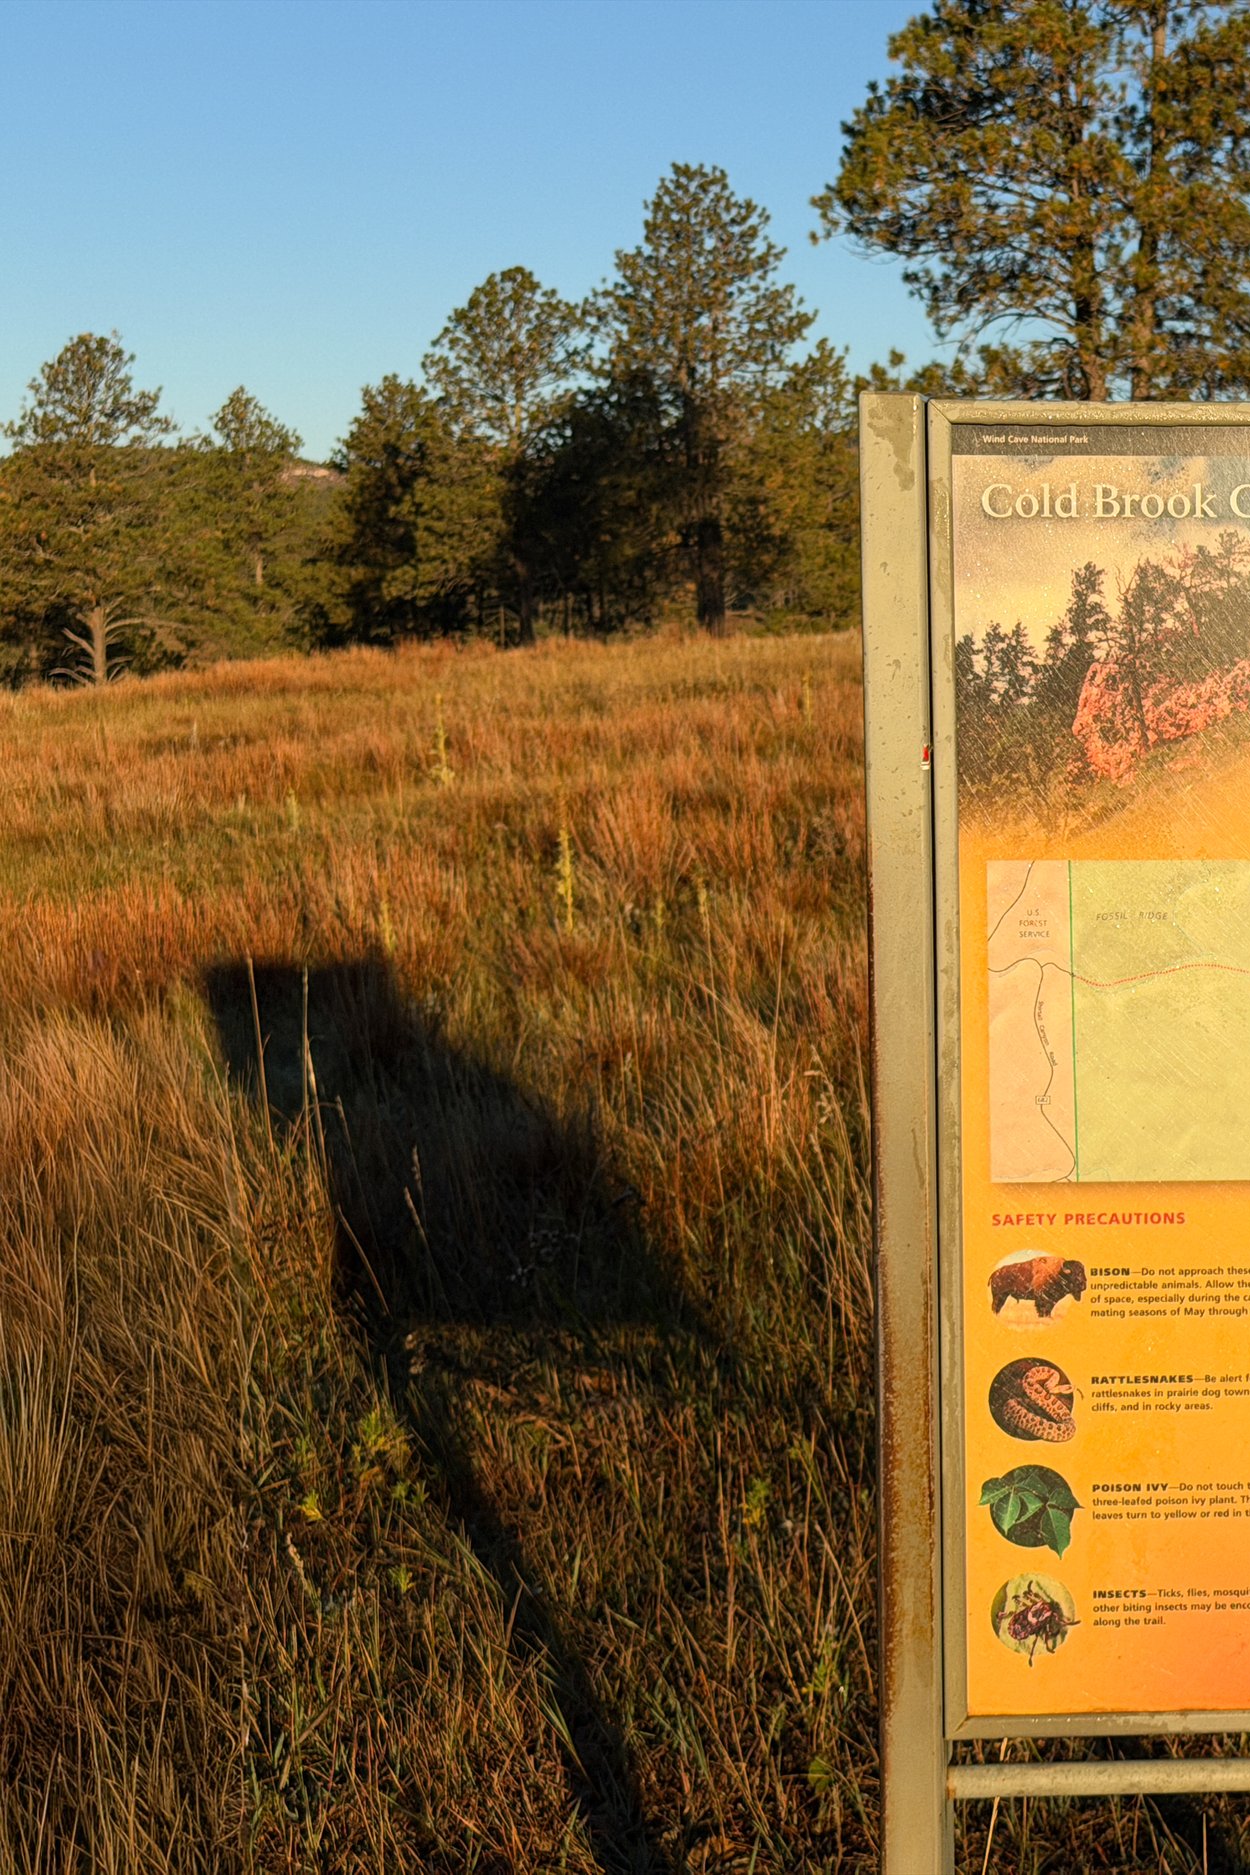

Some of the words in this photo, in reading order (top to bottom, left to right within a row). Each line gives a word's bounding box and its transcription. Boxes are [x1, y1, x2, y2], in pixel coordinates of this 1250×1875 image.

[981, 434, 1005, 444] Wind
[1007, 434, 1028, 444] Cave
[1030, 434, 1067, 444] National
[1069, 434, 1088, 444] Park
[981, 482, 1079, 519] Cold
[1093, 482, 1217, 519] Brook
[991, 1213, 1056, 1226] SAFETY
[1064, 1211, 1185, 1226] PRECAUTIONS
[1158, 1266, 1175, 1276] not
[1178, 1266, 1224, 1278] approach
[1090, 1280, 1158, 1292] unpredictable
[1161, 1279, 1201, 1290] animals.
[1204, 1279, 1234, 1289] Allow
[1089, 1294, 1101, 1304] of
[1103, 1296, 1134, 1306] space,
[1137, 1293, 1185, 1305] especially
[1187, 1293, 1220, 1305] during
[1223, 1292, 1240, 1302] the
[1219, 1373, 1242, 1383] alert
[1091, 1482, 1141, 1492] POISON
[1196, 1481, 1213, 1491] not
[1216, 1481, 1243, 1491] touch
[1092, 1495, 1152, 1506] three-leafed
[1155, 1495, 1188, 1507] poison
[1191, 1495, 1206, 1506] ivy
[1208, 1494, 1237, 1506] plant.
[1186, 1587, 1210, 1599] flies,
